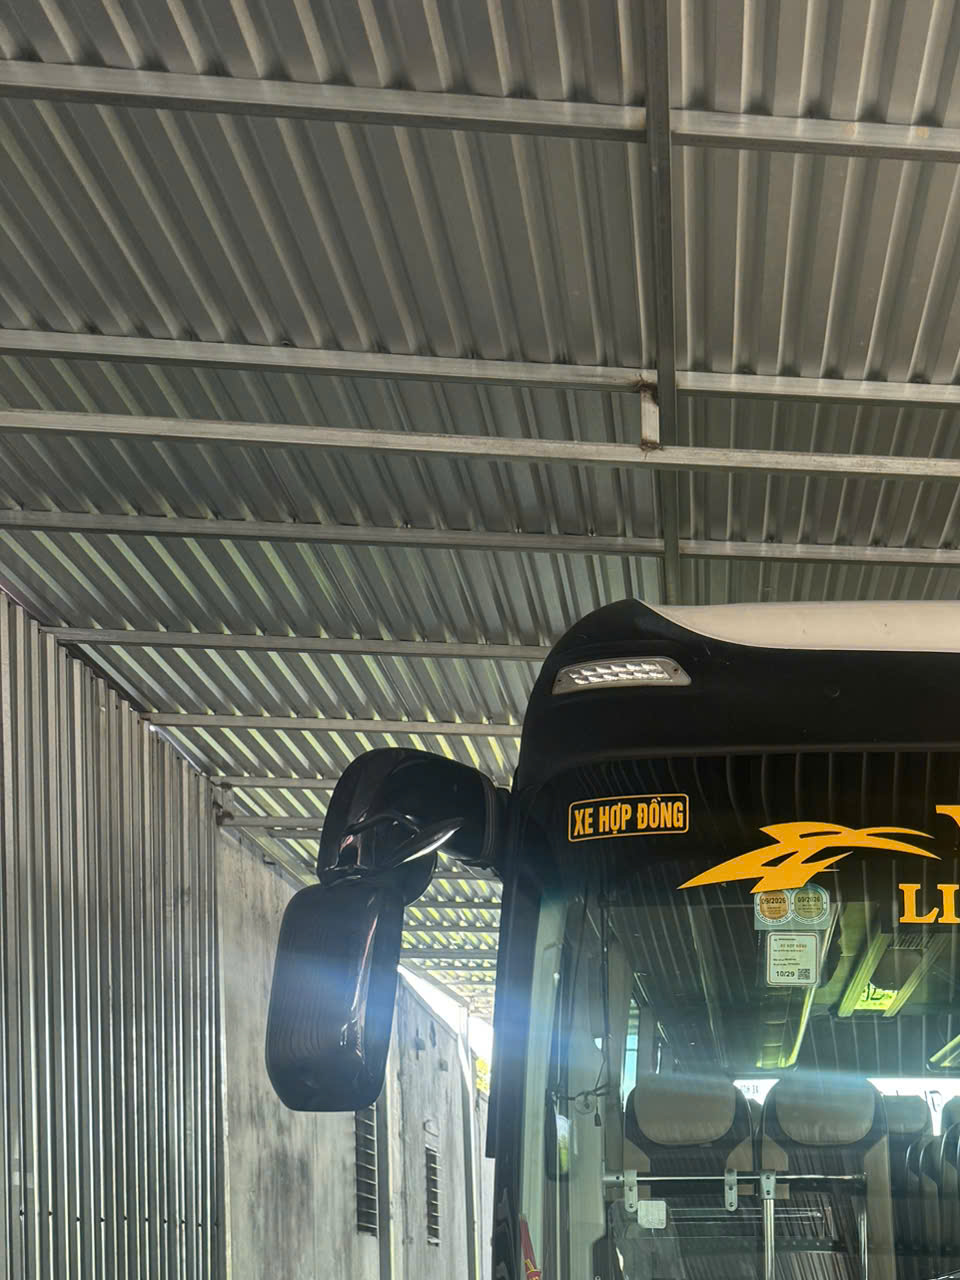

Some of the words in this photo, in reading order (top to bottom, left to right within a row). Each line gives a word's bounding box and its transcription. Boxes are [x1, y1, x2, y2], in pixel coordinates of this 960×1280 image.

[573, 808, 594, 837] XE
[599, 802, 632, 835] HỢP
[637, 797, 684, 830] ĐỒNG
